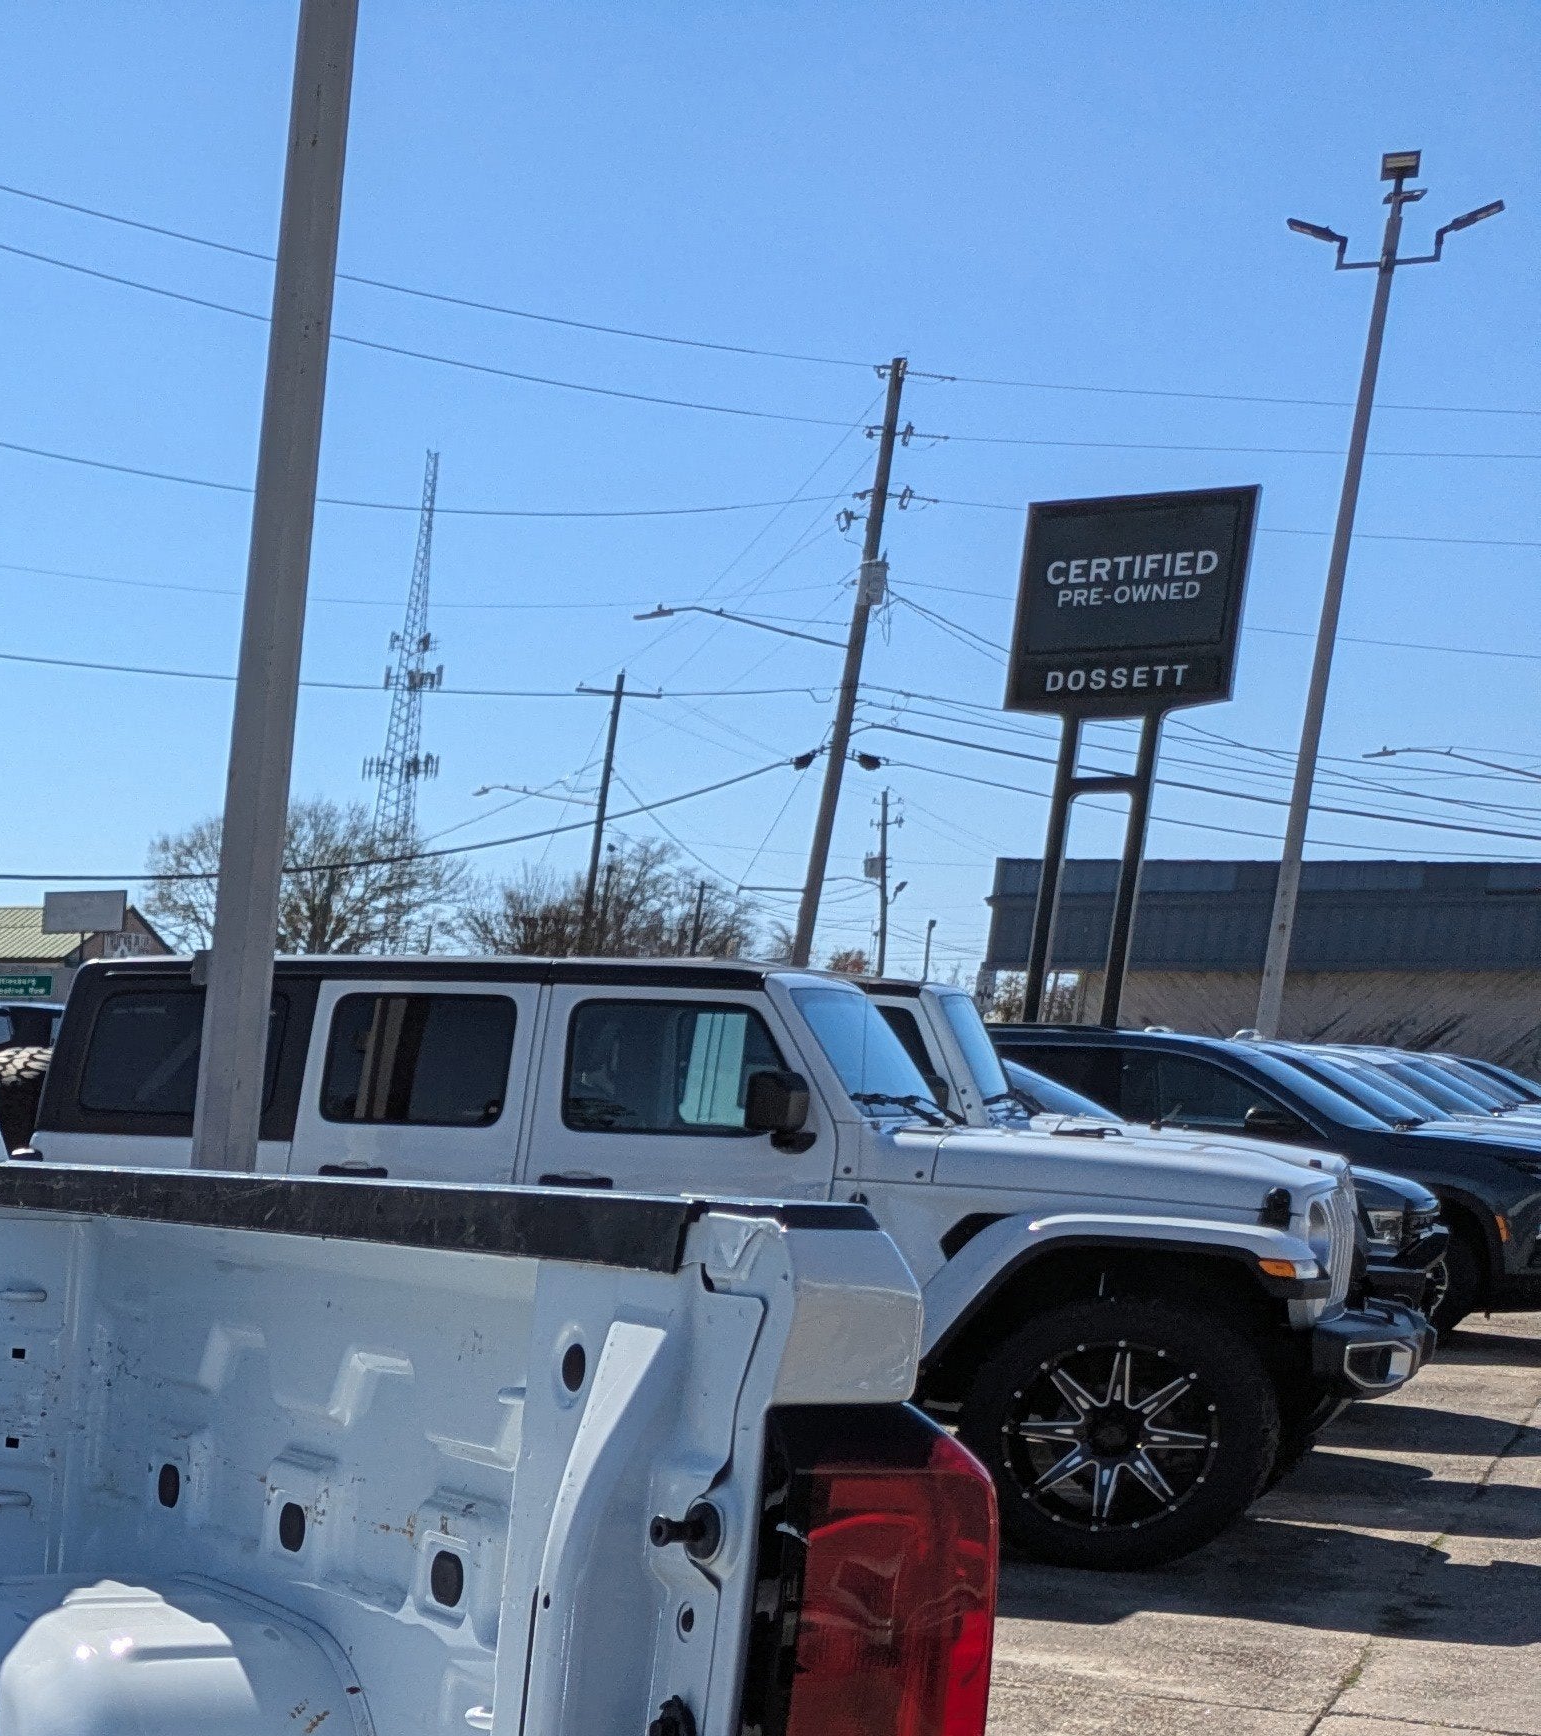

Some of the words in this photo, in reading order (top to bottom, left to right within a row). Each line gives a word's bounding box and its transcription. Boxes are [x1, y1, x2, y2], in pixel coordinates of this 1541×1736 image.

[1046, 550, 1219, 585] CERTIFIED
[1057, 581, 1201, 608] PRE-OWNED
[1045, 664, 1189, 692] DOSSETT
